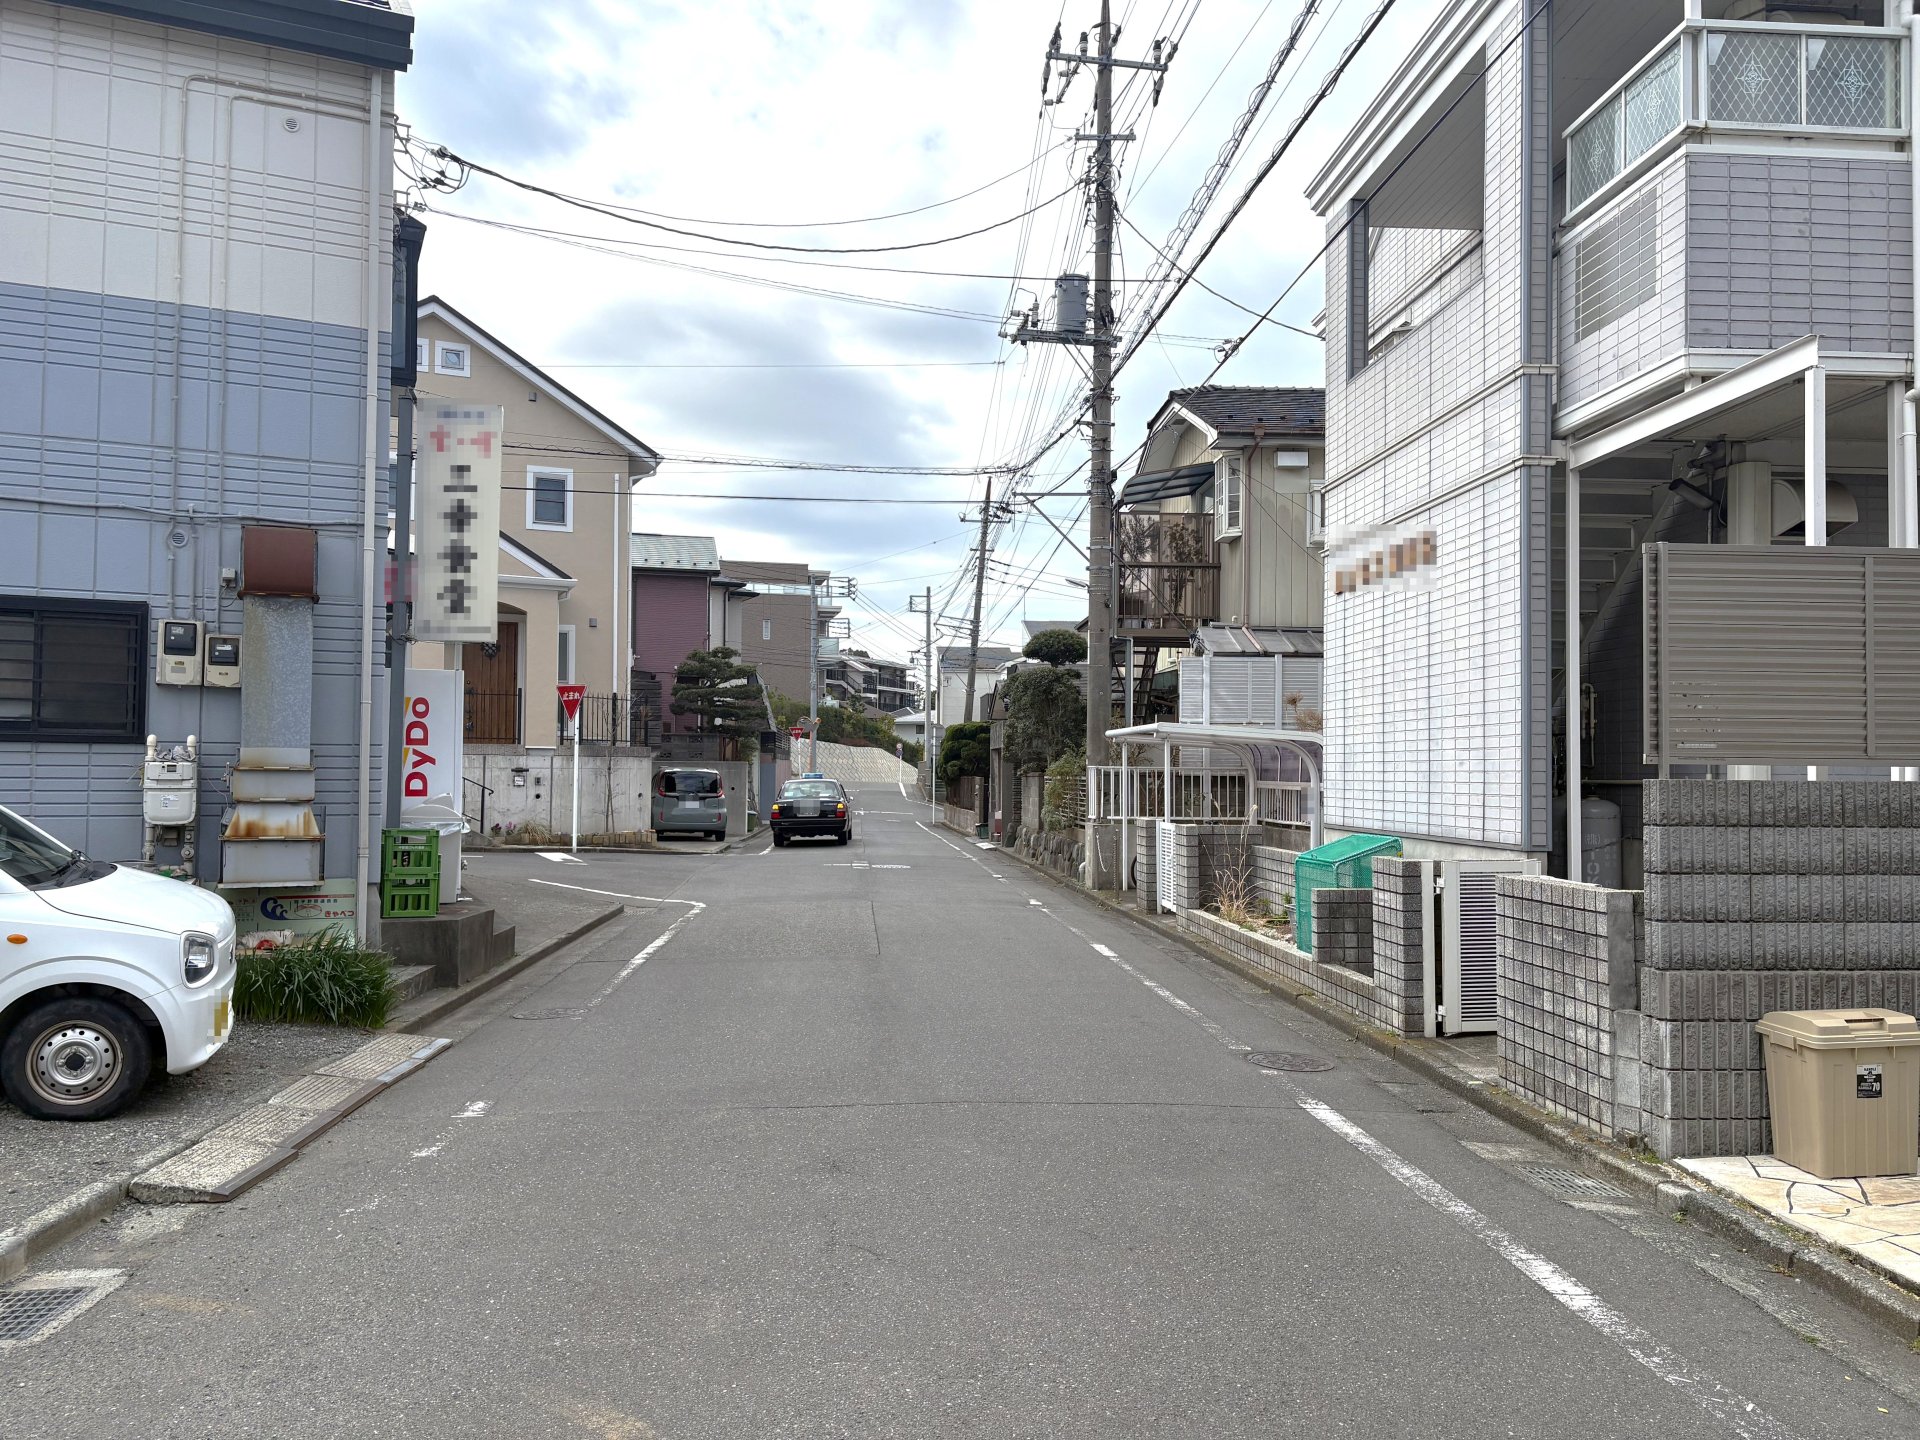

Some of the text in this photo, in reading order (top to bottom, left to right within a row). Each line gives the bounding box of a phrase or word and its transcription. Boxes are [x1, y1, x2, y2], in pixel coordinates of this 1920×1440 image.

[562, 691, 580, 701] 止まれ
[404, 696, 437, 797] DyDo
[1872, 1082, 1880, 1091] 70
